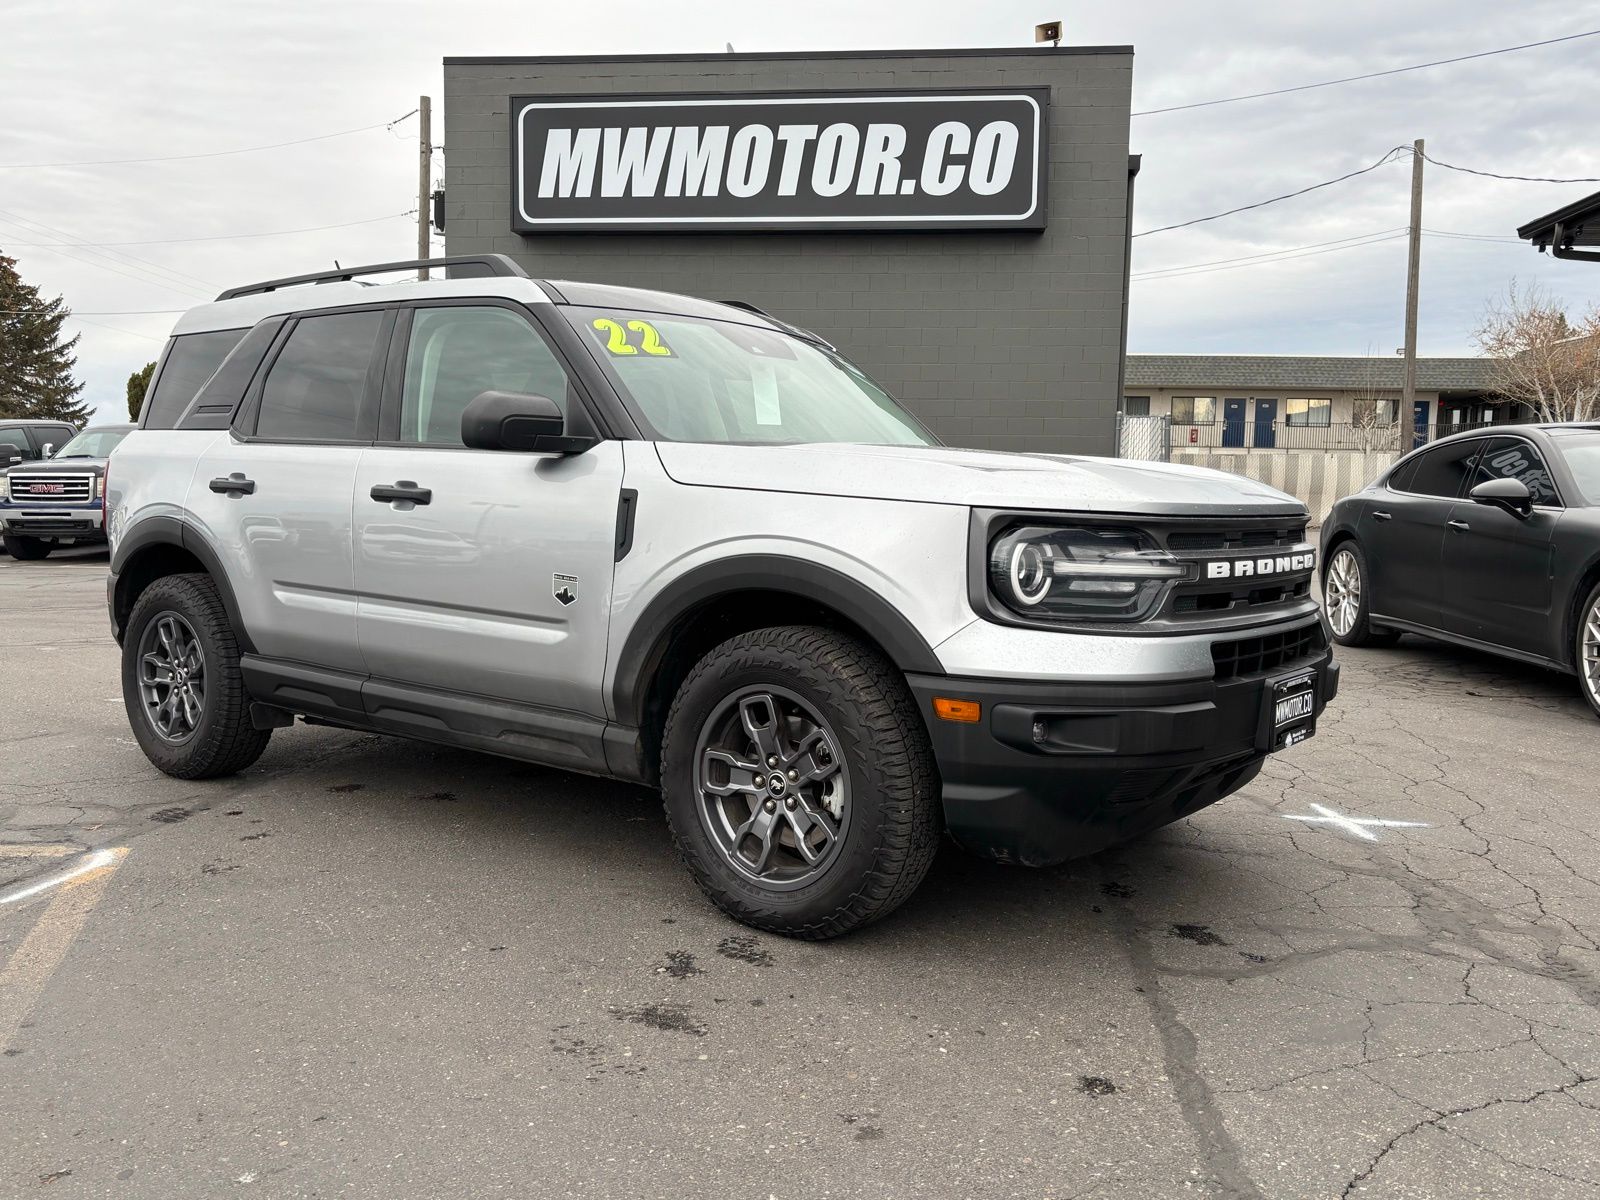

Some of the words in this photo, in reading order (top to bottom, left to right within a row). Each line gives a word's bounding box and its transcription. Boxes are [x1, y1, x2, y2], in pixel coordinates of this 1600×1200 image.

[537, 120, 1020, 199] MWMOTOR.CO
[592, 318, 671, 356] 22
[30, 484, 64, 493] GMC
[1207, 553, 1314, 579] BRONCO
[1275, 693, 1312, 724] MWMOTOR.CO
